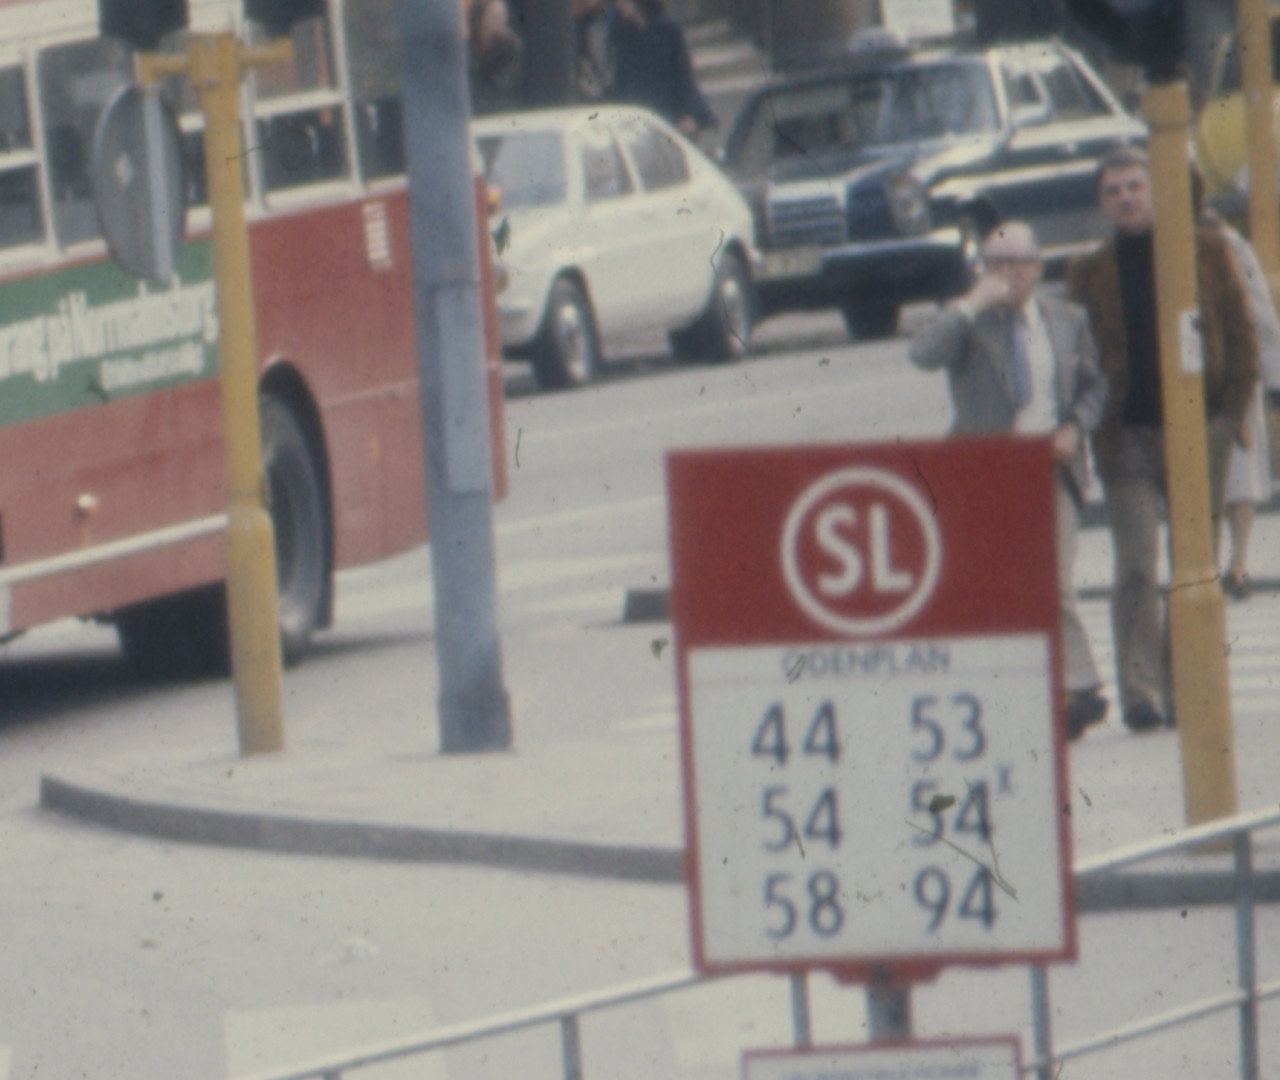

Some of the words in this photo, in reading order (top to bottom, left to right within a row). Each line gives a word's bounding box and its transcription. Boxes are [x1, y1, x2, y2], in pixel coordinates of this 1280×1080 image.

[814, 502, 913, 597] SL
[781, 644, 950, 679] ODENPLAN
[750, 700, 840, 767] 44
[909, 691, 986, 764] 53
[761, 784, 840, 854] 54
[910, 778, 993, 850] 54
[763, 868, 844, 941] 58
[912, 864, 997, 935] 94
